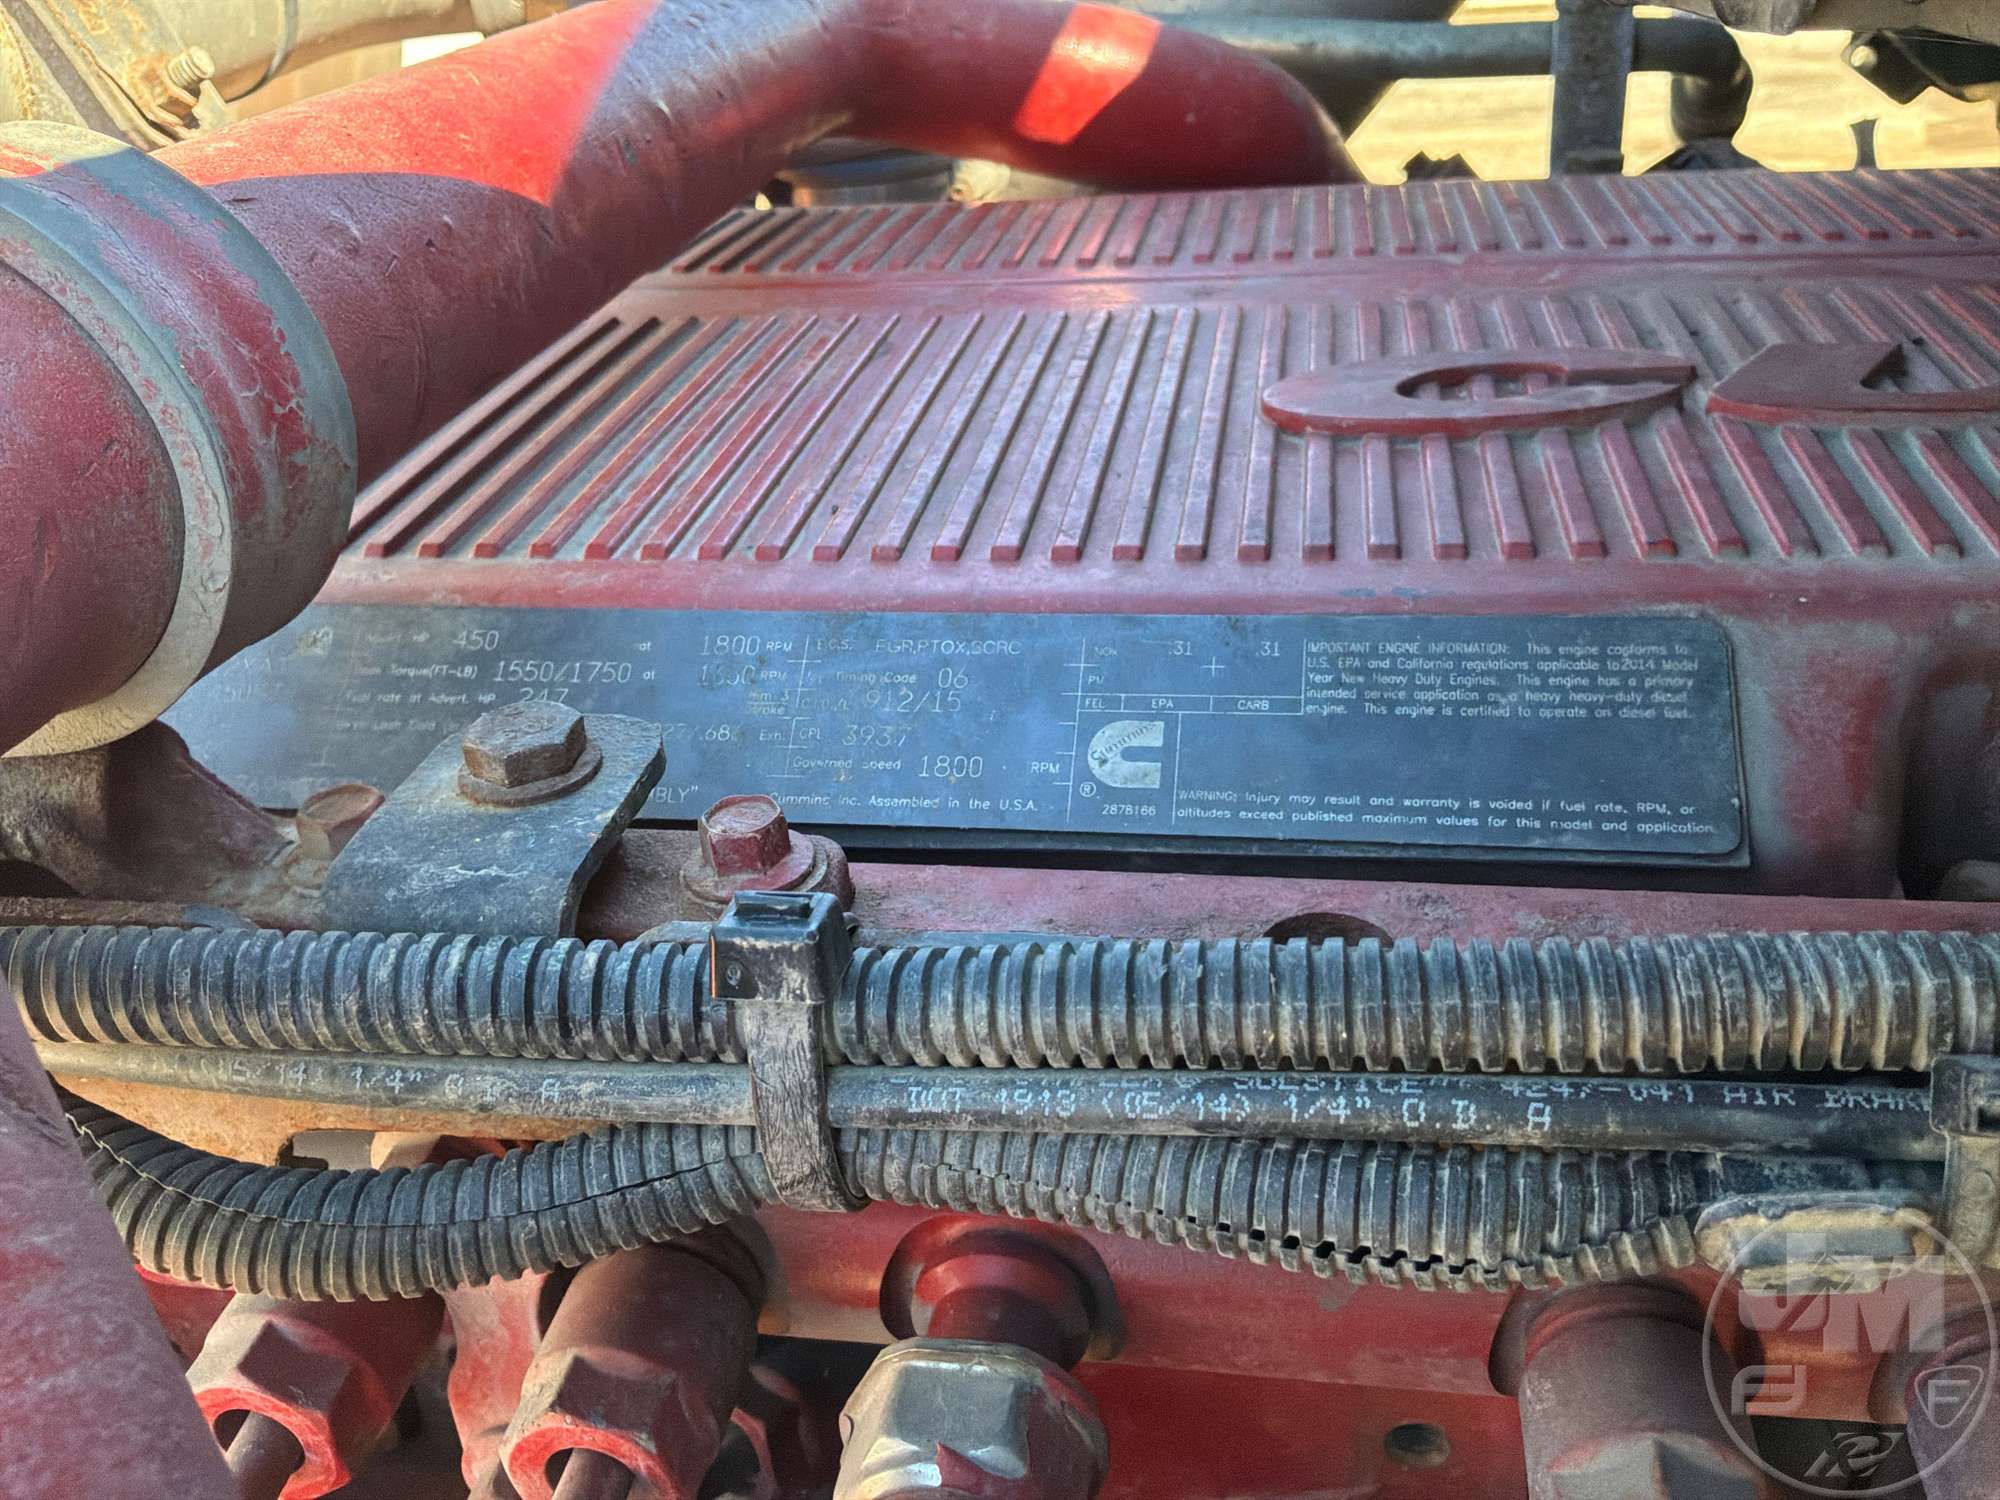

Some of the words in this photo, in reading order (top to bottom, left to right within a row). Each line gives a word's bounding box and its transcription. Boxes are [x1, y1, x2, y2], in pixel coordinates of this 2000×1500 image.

[452, 630, 499, 650] 450
[638, 641, 652, 651] at
[701, 635, 760, 656] 1800
[766, 641, 793, 652] RPM
[1307, 641, 1371, 653] IMPORTANT
[1378, 642, 1420, 654] ENGINE
[1429, 642, 1510, 655] INFORMATION:
[1527, 643, 1552, 655] This
[1558, 645, 1600, 657] engine
[1674, 645, 1689, 655] to
[493, 660, 632, 683] 1550/1750
[1307, 657, 1330, 668] U.S.
[1338, 657, 1361, 668] EPA
[1367, 658, 1390, 669] and
[1397, 657, 1454, 669] California
[1462, 659, 1529, 673] regulations
[1536, 659, 1600, 673] applicable
[1662, 659, 1698, 671] Model
[643, 671, 655, 680] at
[760, 670, 788, 682] RPM
[884, 671, 917, 684] Code
[938, 667, 969, 689] 06
[1307, 672, 1334, 683] Year
[1373, 673, 1409, 687] Heavy
[1415, 673, 1442, 687] Duty
[1450, 673, 1500, 688] Engines.
[1517, 674, 1542, 686] This
[1549, 675, 1590, 688] engine
[1597, 675, 1620, 687] has
[1643, 675, 1694, 689] primary
[478, 693, 497, 704] HP
[1085, 698, 1105, 709] FEL
[1151, 699, 1174, 709] EPA
[1237, 700, 1270, 711] CARB
[1306, 688, 1357, 699] intended
[1364, 688, 1406, 700] service
[1413, 689, 1479, 702] application
[1525, 690, 1561, 704] heavy
[1569, 690, 1643, 704] heavy-duty
[1650, 690, 1688, 702] diesel
[1305, 704, 1348, 717] engine.
[1364, 702, 1388, 715] This
[1395, 704, 1435, 718] engine
[1442, 704, 1453, 716] is
[1460, 705, 1510, 717] certified
[1518, 705, 1531, 718] to
[1539, 706, 1587, 720] operate
[1594, 708, 1612, 718] on
[1619, 706, 1656, 719] diesel
[919, 755, 984, 778] 1800
[1030, 763, 1061, 774] RPM
[839, 794, 861, 806] Inc.
[868, 795, 939, 808] Assembled
[948, 798, 960, 809] in
[969, 798, 991, 810] the
[1000, 800, 1038, 811] U.S.A.
[1178, 790, 1238, 803] WARNING:
[1244, 792, 1280, 804] Injury
[1289, 795, 1316, 806] may
[1324, 794, 1361, 806] result
[1369, 796, 1394, 807] and
[1403, 797, 1460, 810] warranty
[1469, 797, 1480, 809] is
[1489, 799, 1533, 810] voided
[1541, 799, 1551, 811] if
[1560, 800, 1586, 812] fuel
[1680, 805, 1696, 815] or
[1177, 807, 1231, 819] altitudes
[1238, 809, 1284, 820] exceed
[1292, 810, 1353, 823] published
[1362, 813, 1427, 825] maximum
[1436, 815, 1479, 826] values
[1487, 816, 1508, 828] for
[1516, 817, 1541, 829] this
[1550, 818, 1593, 830] model
[1601, 820, 1628, 832] and
